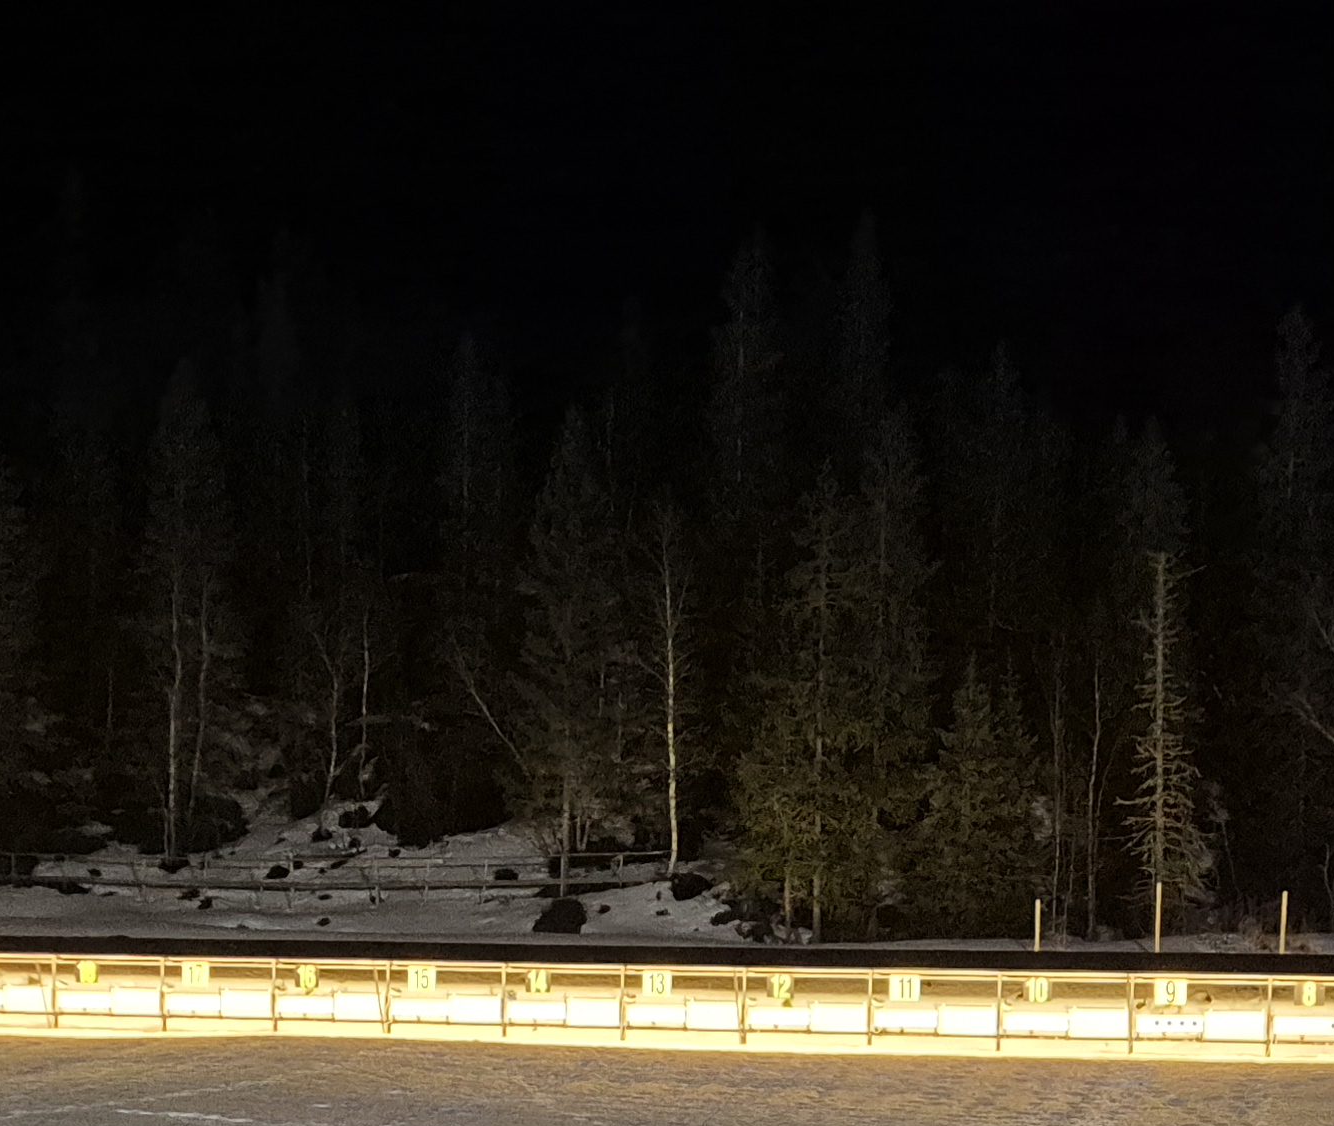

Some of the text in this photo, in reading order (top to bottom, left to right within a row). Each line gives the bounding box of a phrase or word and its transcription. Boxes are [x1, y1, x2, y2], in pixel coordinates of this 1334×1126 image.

[188, 964, 202, 984] 17
[413, 968, 429, 989] 15
[528, 970, 546, 993] 14
[649, 973, 665, 994] 13
[771, 974, 791, 999] 12
[898, 977, 912, 999] 11
[1026, 978, 1048, 1003] 10
[1165, 980, 1176, 1003] 9
[1303, 982, 1316, 1007] 8
